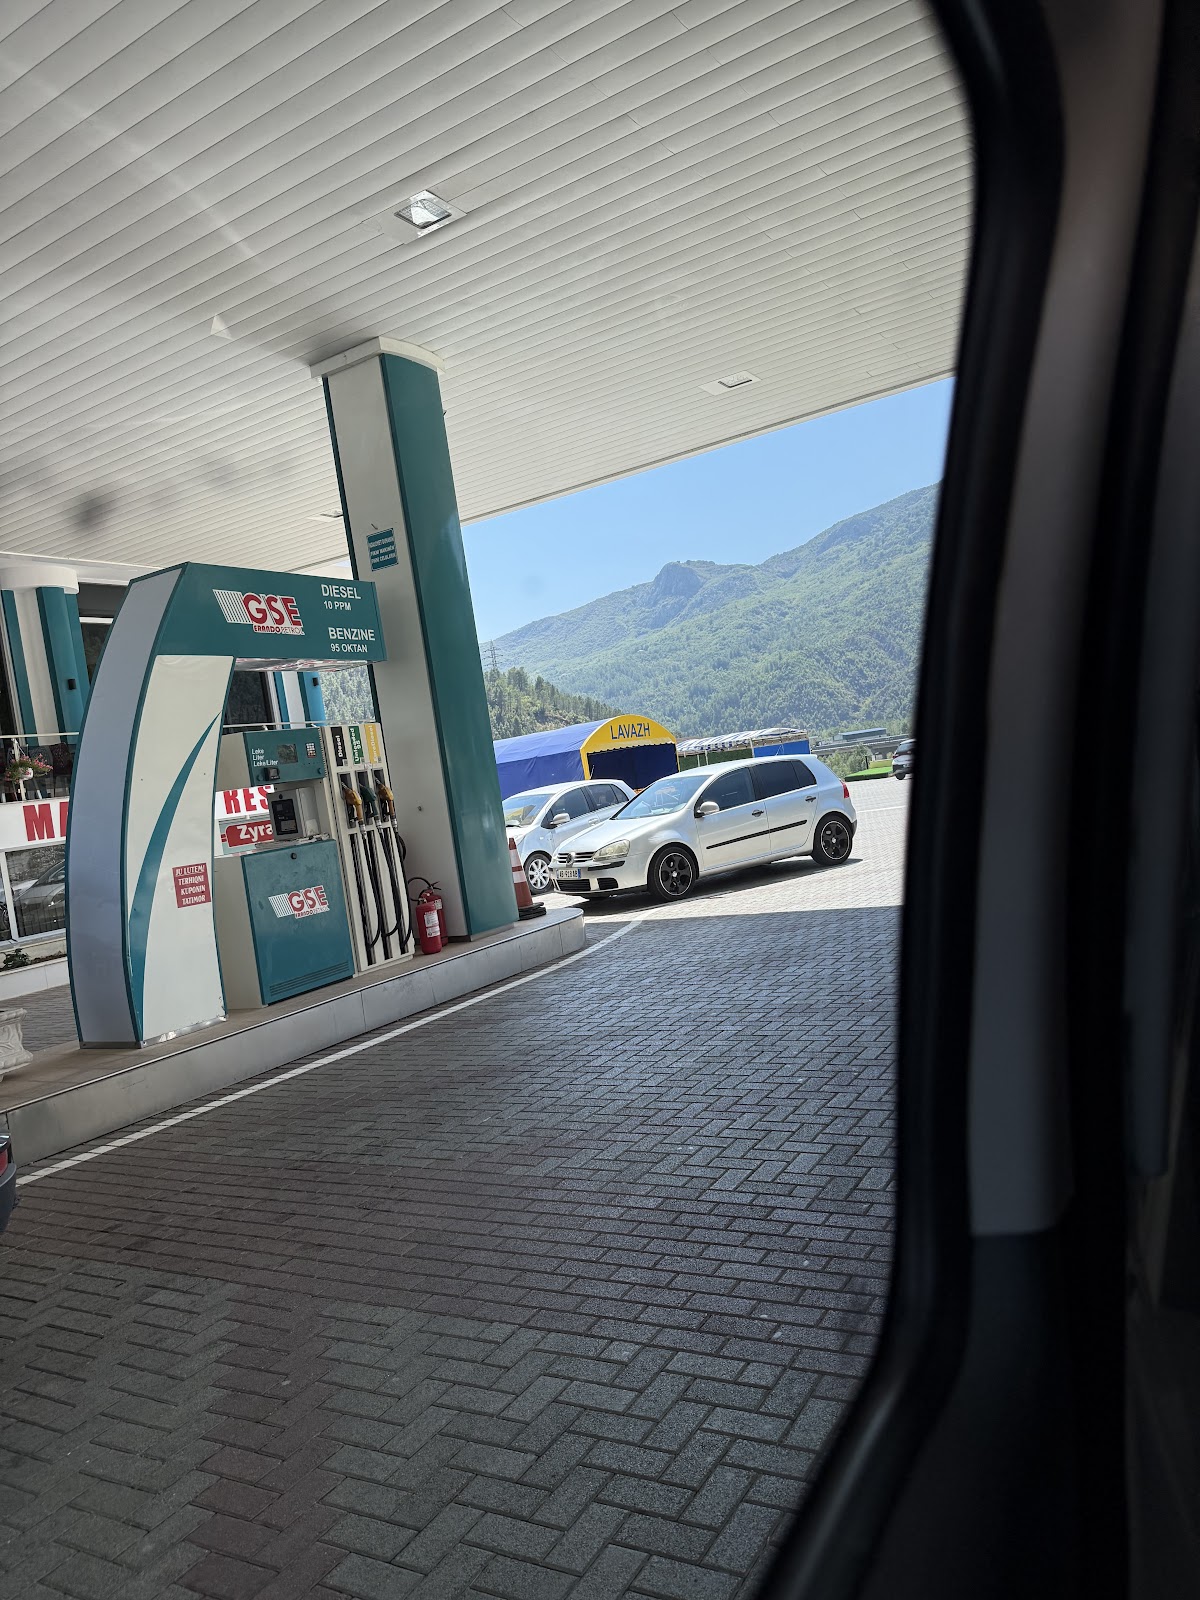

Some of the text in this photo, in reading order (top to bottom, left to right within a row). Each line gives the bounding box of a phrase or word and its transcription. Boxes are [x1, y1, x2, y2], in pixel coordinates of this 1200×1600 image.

[321, 584, 361, 600] DIESEL
[242, 593, 303, 626] GSE
[323, 601, 351, 611] 10 PPM
[328, 626, 376, 641] BENZINE
[330, 643, 368, 653] 95 OKTAN
[610, 722, 651, 740] LAVAZH
[335, 735, 343, 758] Diesel
[237, 823, 273, 842] Zyra
[287, 885, 328, 912] GSE
